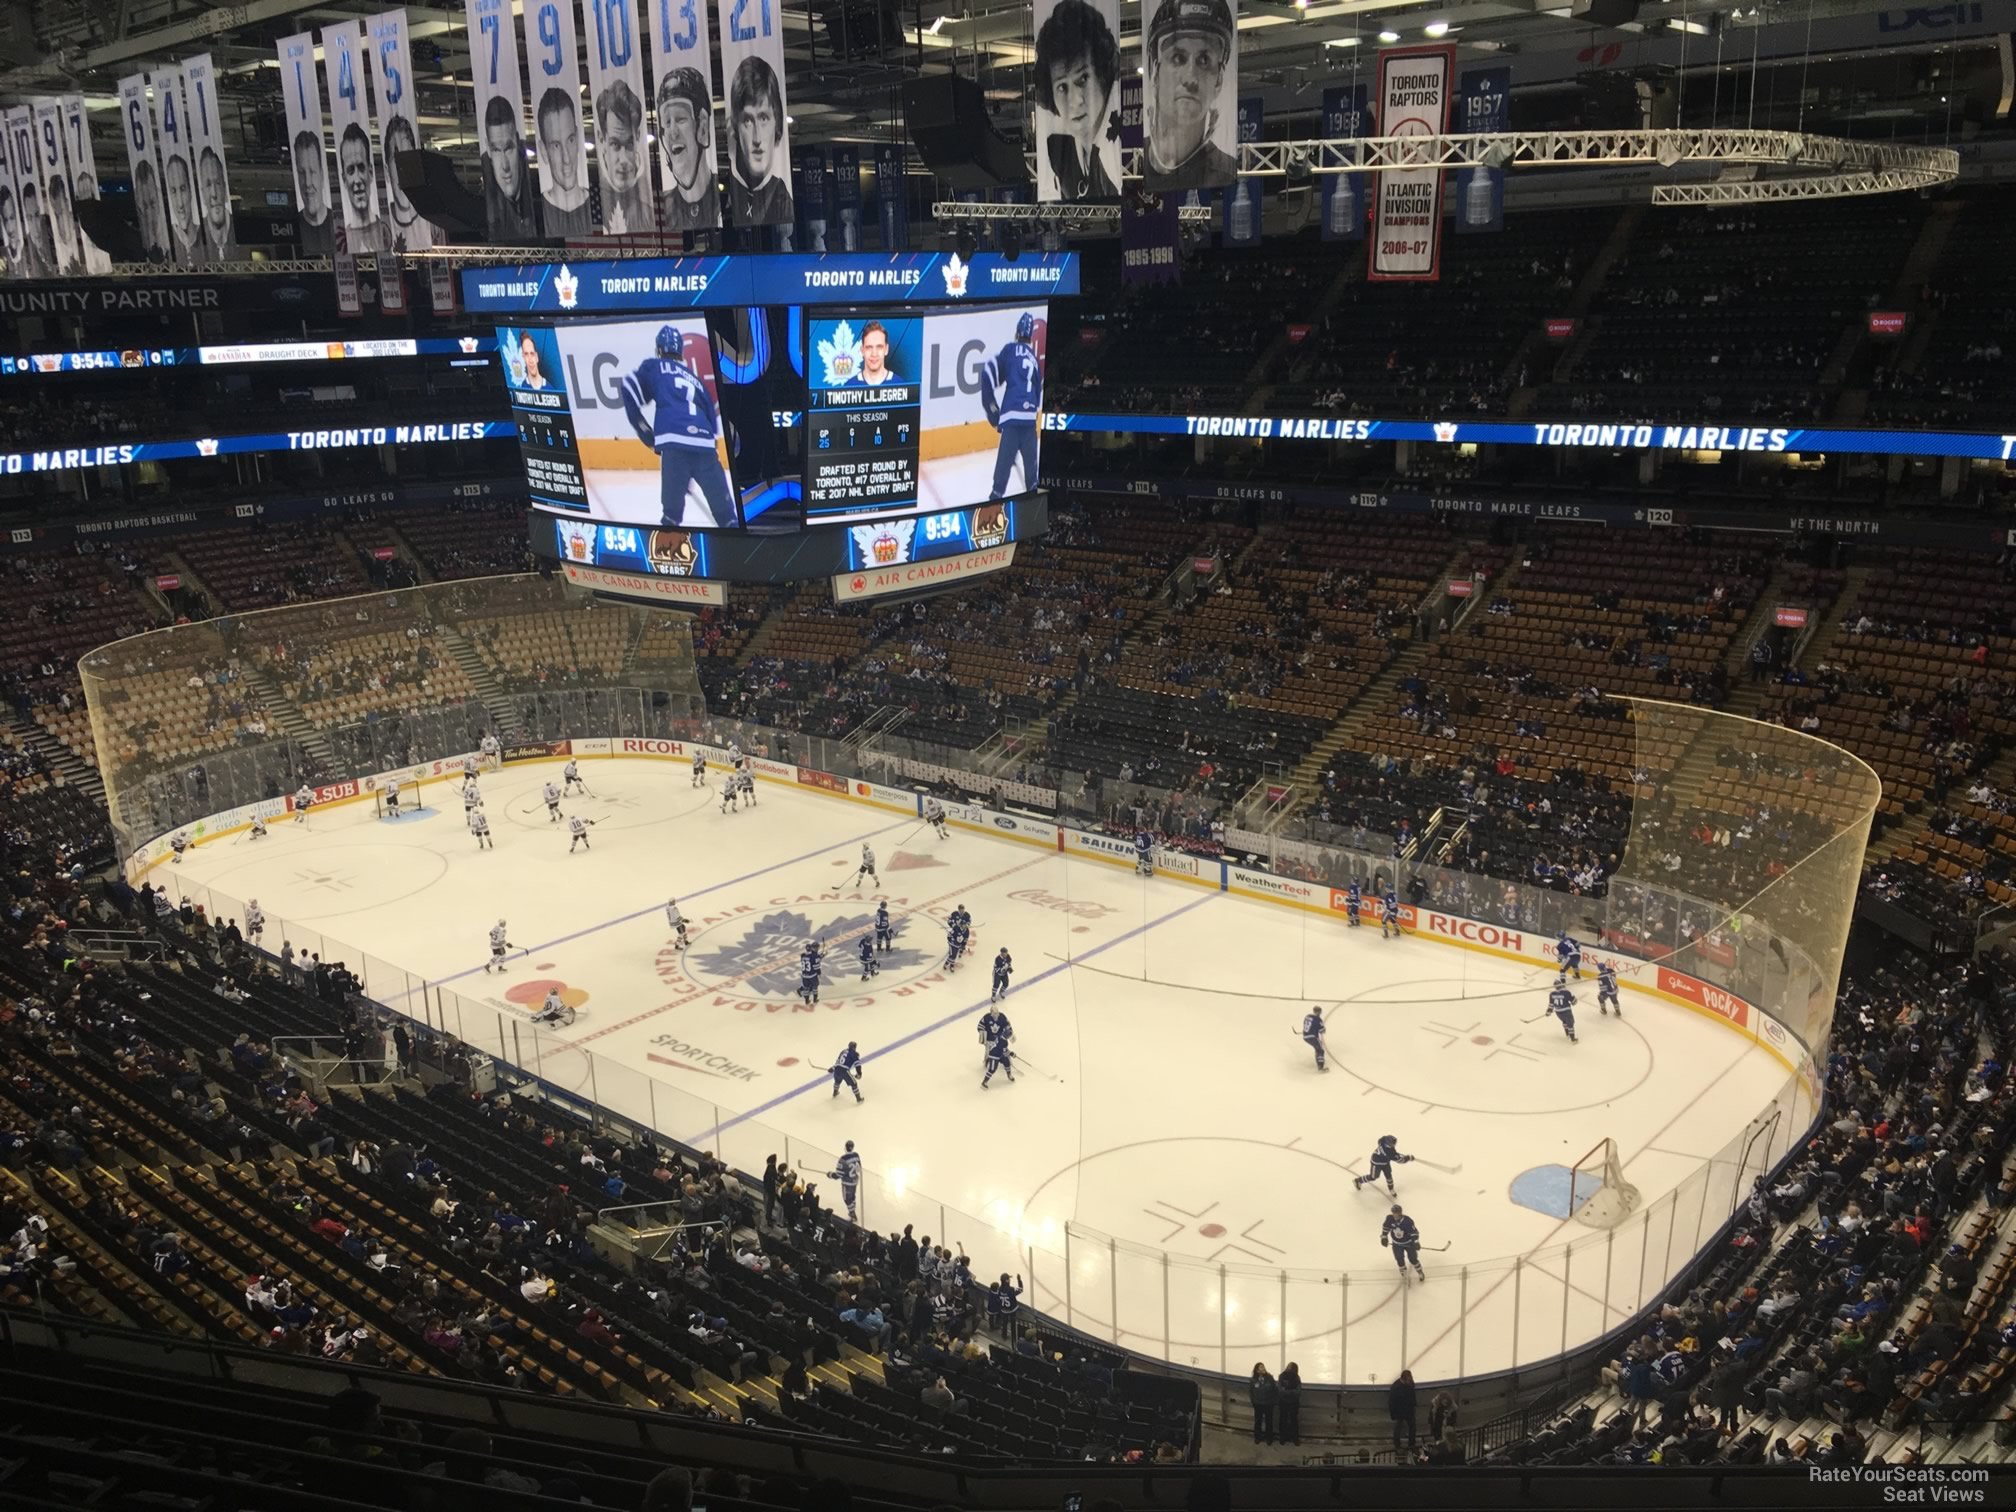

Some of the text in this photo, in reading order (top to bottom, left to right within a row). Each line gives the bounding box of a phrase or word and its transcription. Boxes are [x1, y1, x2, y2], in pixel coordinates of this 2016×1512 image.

[538, 4, 563, 77] 9
[592, 0, 632, 71] 10
[479, 14, 499, 85] 7
[338, 49, 357, 112] 4
[381, 40, 403, 105] 5
[1391, 73, 1439, 91] TORONTO
[295, 61, 306, 121] 1
[1389, 90, 1439, 108] RAPTORS
[196, 81, 209, 137] 1
[1466, 92, 1503, 117] 1967
[129, 100, 145, 152] 6
[164, 91, 179, 144] 4
[43, 119, 58, 167] 9
[69, 114, 83, 164] 7
[1386, 182, 1433, 198] ATLANTIC
[1385, 199, 1431, 214] DIVISION
[1383, 216, 1430, 227] CHAMPIONS
[601, 274, 708, 294] TORONTO MARLIES
[804, 269, 920, 287] TORONTO MARLIES
[991, 267, 1061, 283] TORONTO MARLIES
[101, 288, 219, 311] PARTNER
[478, 281, 539, 298] TORONTO MARLIES
[71, 352, 103, 370] 9:54
[258, 348, 318, 360] DRAUGHT DECK
[1022, 358, 1034, 393] 7
[673, 376, 697, 416] 7
[827, 390, 864, 405] TIMOTHY
[864, 387, 908, 404] LILJEGREN
[846, 412, 889, 423] THIS SEASON
[287, 422, 486, 450] TORONTO MARLIES
[819, 429, 829, 439] GP
[898, 424, 910, 433] PTS
[1186, 416, 1371, 440] TORONTO MARLIES
[1534, 423, 1789, 452] TORONTO MARLIES
[819, 438, 830, 449] 25
[32, 444, 134, 472] MARLIES
[820, 464, 856, 477] DRAFTED
[872, 461, 897, 473] ROUND
[898, 460, 908, 470] BY
[869, 473, 901, 485] OVERALL
[903, 471, 911, 481] IN
[810, 481, 915, 501] THE 2017 NHL ENTRY DRAFT
[1066, 479, 1094, 490] LEAFS
[1217, 487, 1283, 500] GO LEAFS GO
[323, 491, 394, 507] GO LEAFS GO
[1429, 498, 1581, 517] TORONTO MAPLE LEAFS
[75, 512, 198, 535] TORONTO RAPTORS BASKETBALL
[1648, 509, 1672, 523] 120
[1789, 518, 1880, 534] WE THE NORTH
[925, 515, 961, 541] 9:54
[605, 527, 637, 552] 9:54
[874, 550, 1008, 587] AIR CANADA CENTRE
[581, 571, 710, 597] AIR CANADA CENTRE
[518, 747, 546, 757] Hortons
[624, 739, 683, 756] RICOH
[752, 760, 790, 777] Scotiabank
[1032, 826, 1051, 836] Further
[1080, 835, 1135, 855] SAILUN
[1163, 854, 1194, 871] intact
[1234, 872, 1312, 897] WeatherTech
[1429, 913, 1523, 951] RICOH
